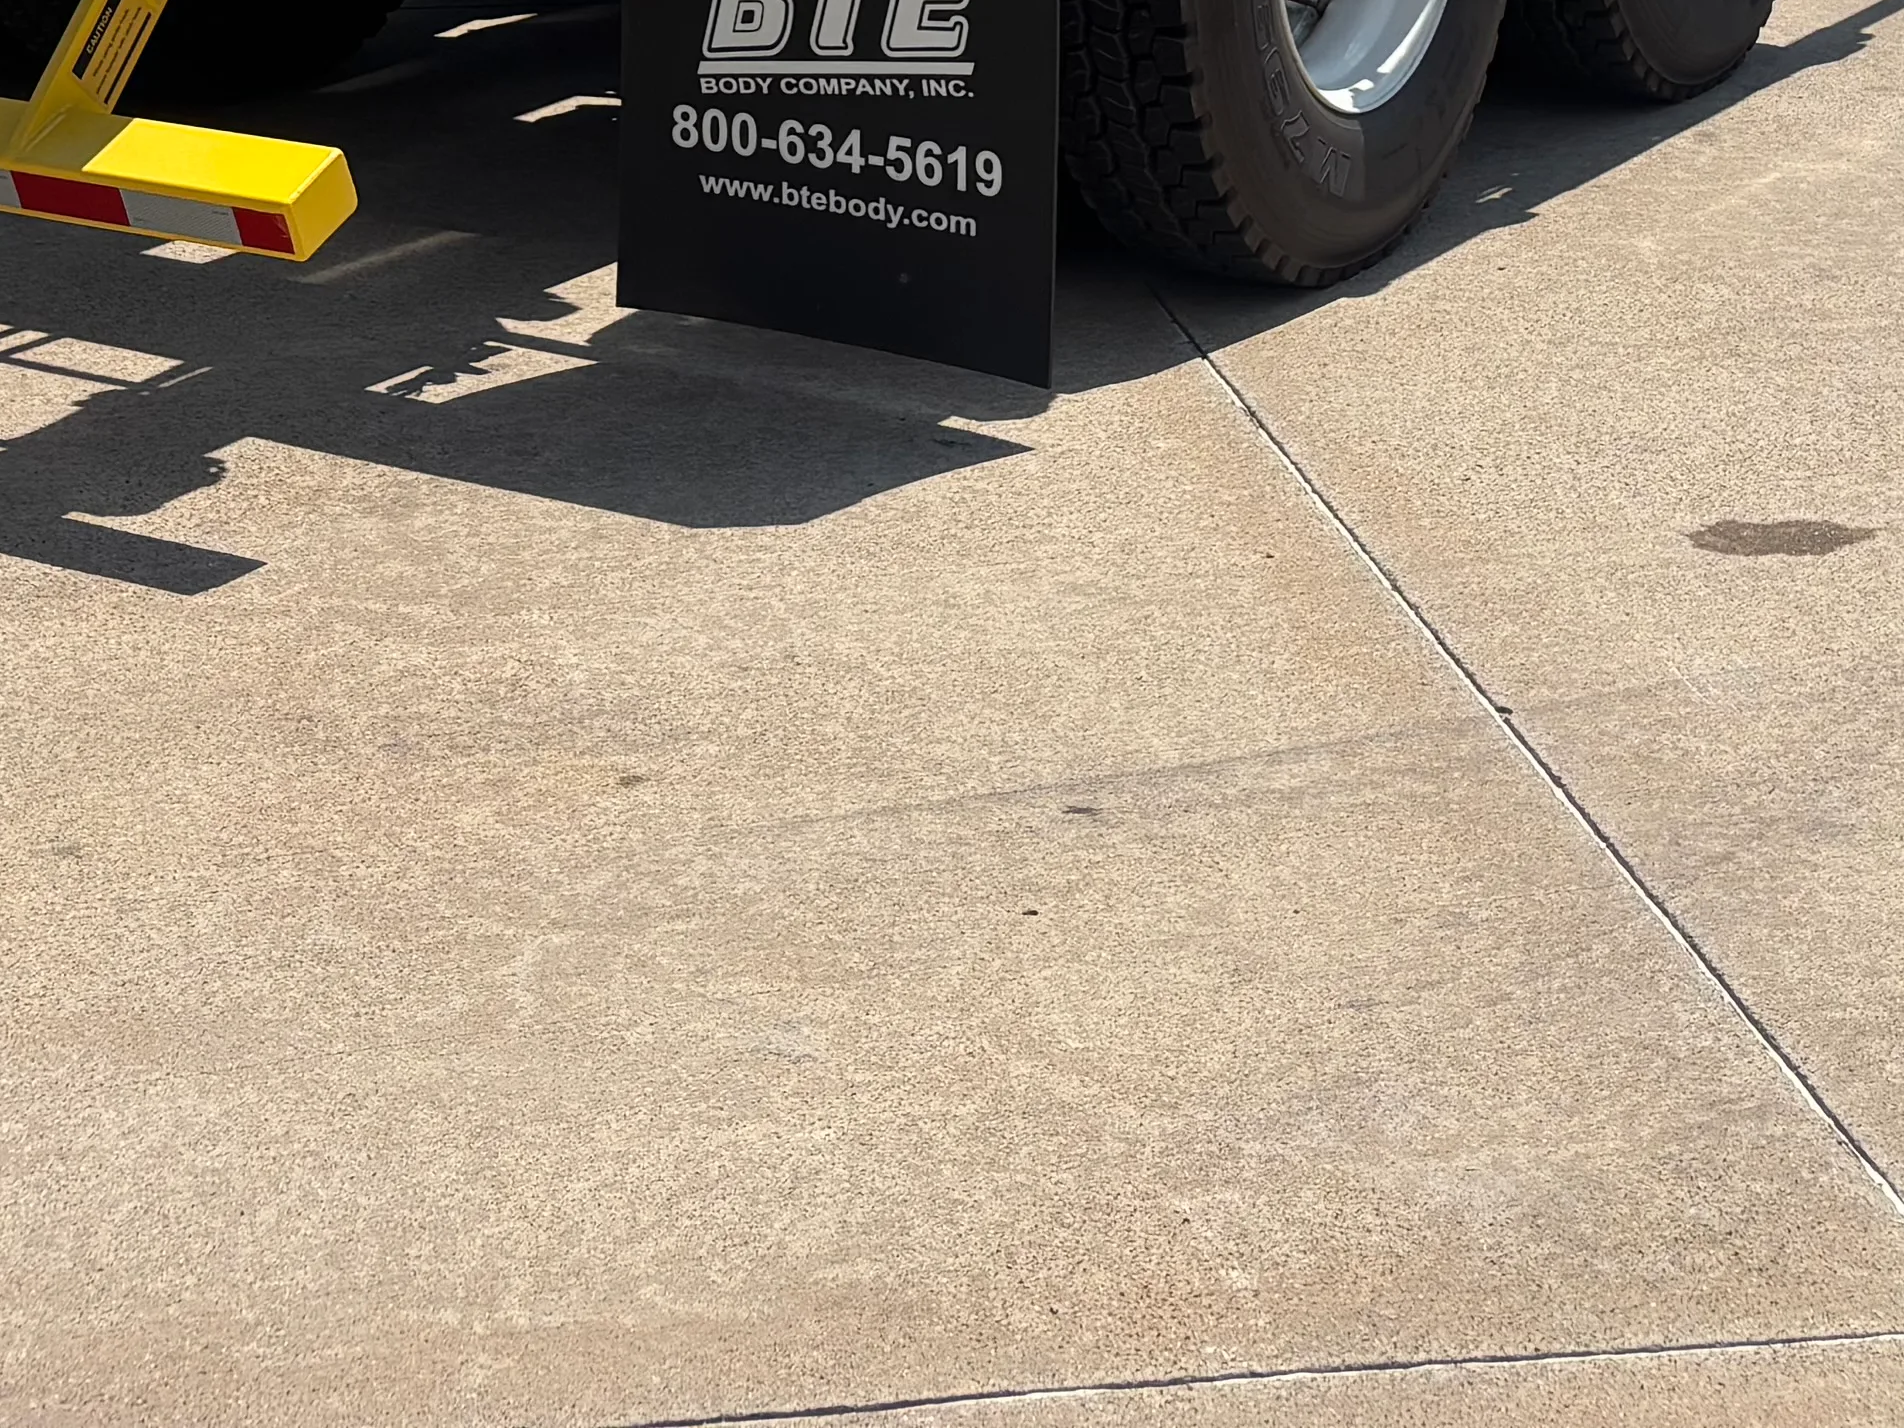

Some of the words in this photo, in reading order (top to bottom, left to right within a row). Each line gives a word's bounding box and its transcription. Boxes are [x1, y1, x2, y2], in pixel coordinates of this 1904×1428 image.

[86, 6, 114, 55] CAUTION
[699, 77, 774, 95] BODY
[780, 78, 916, 100] COMPANY,
[922, 79, 975, 98] INC.
[671, 104, 1003, 198] 800-634-5619
[698, 174, 977, 237] www.btebody.com
